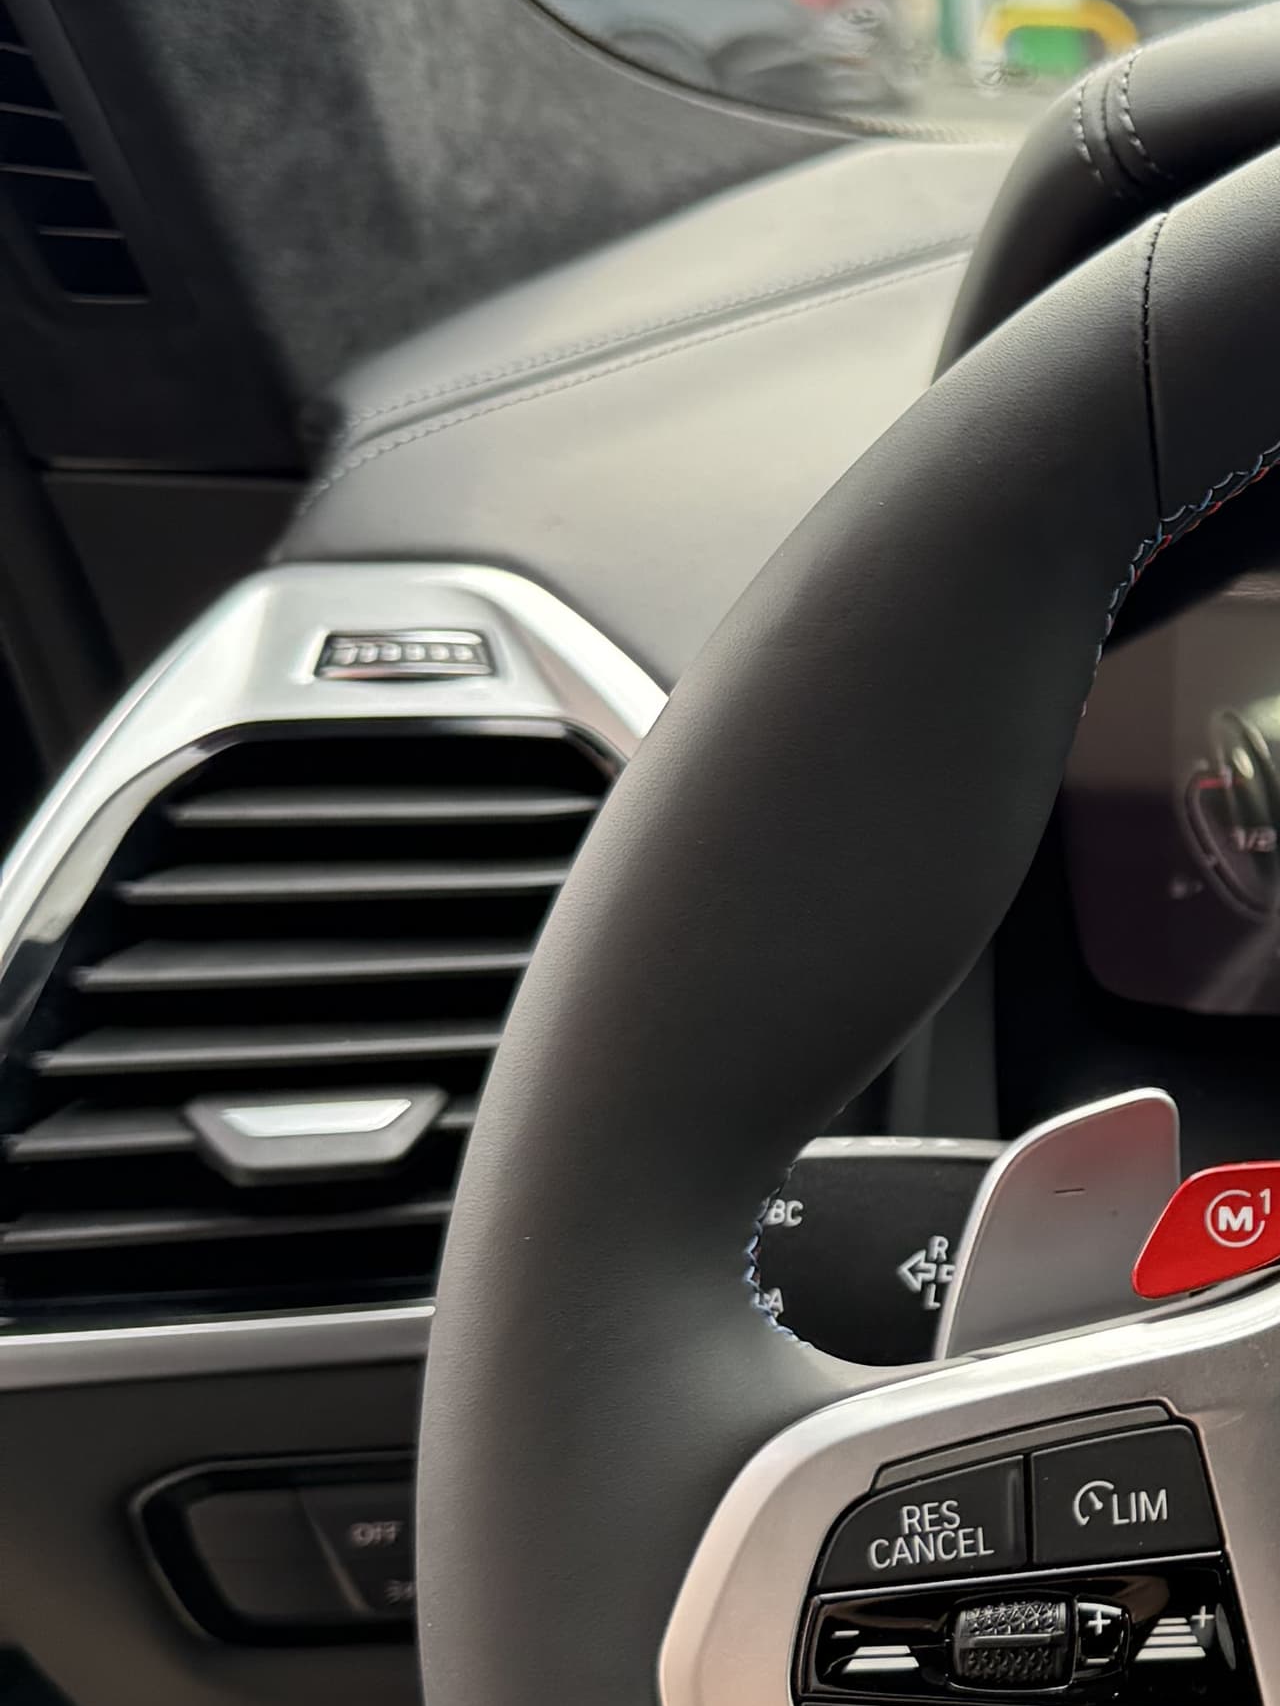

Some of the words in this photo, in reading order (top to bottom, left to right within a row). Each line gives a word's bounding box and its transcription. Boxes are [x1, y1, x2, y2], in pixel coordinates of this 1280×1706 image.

[763, 1198, 805, 1227] BC
[901, 1500, 960, 1536] RES
[1112, 1488, 1170, 1526] LIM
[868, 1528, 995, 1571] CANCEL
